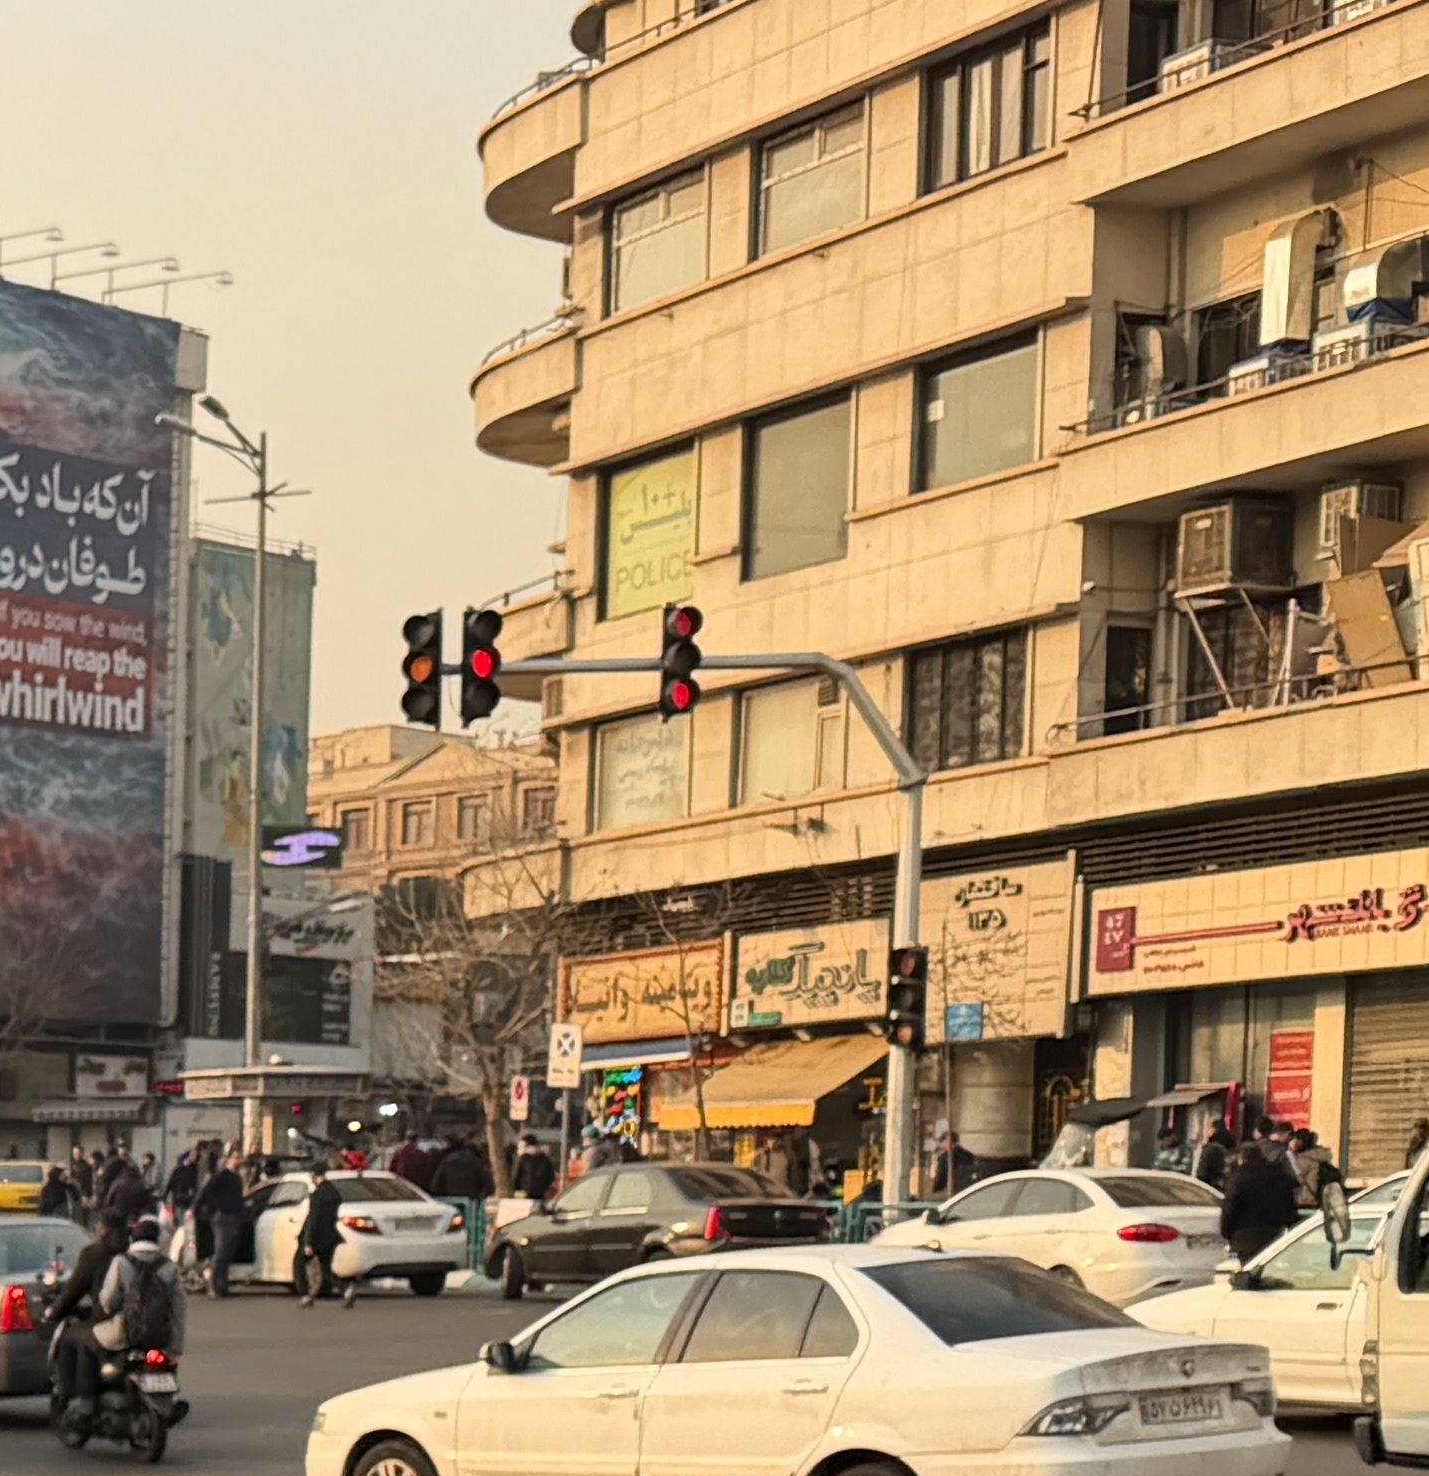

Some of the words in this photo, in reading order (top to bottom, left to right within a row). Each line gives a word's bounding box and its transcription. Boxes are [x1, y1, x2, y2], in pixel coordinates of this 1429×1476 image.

[35, 461, 82, 527] باد
[44, 535, 147, 604] طوفان
[11, 606, 41, 630] you
[44, 611, 77, 633] sow
[79, 614, 105, 638] the
[26, 636, 62, 668] will
[64, 646, 111, 681] reap
[112, 646, 148, 680] the
